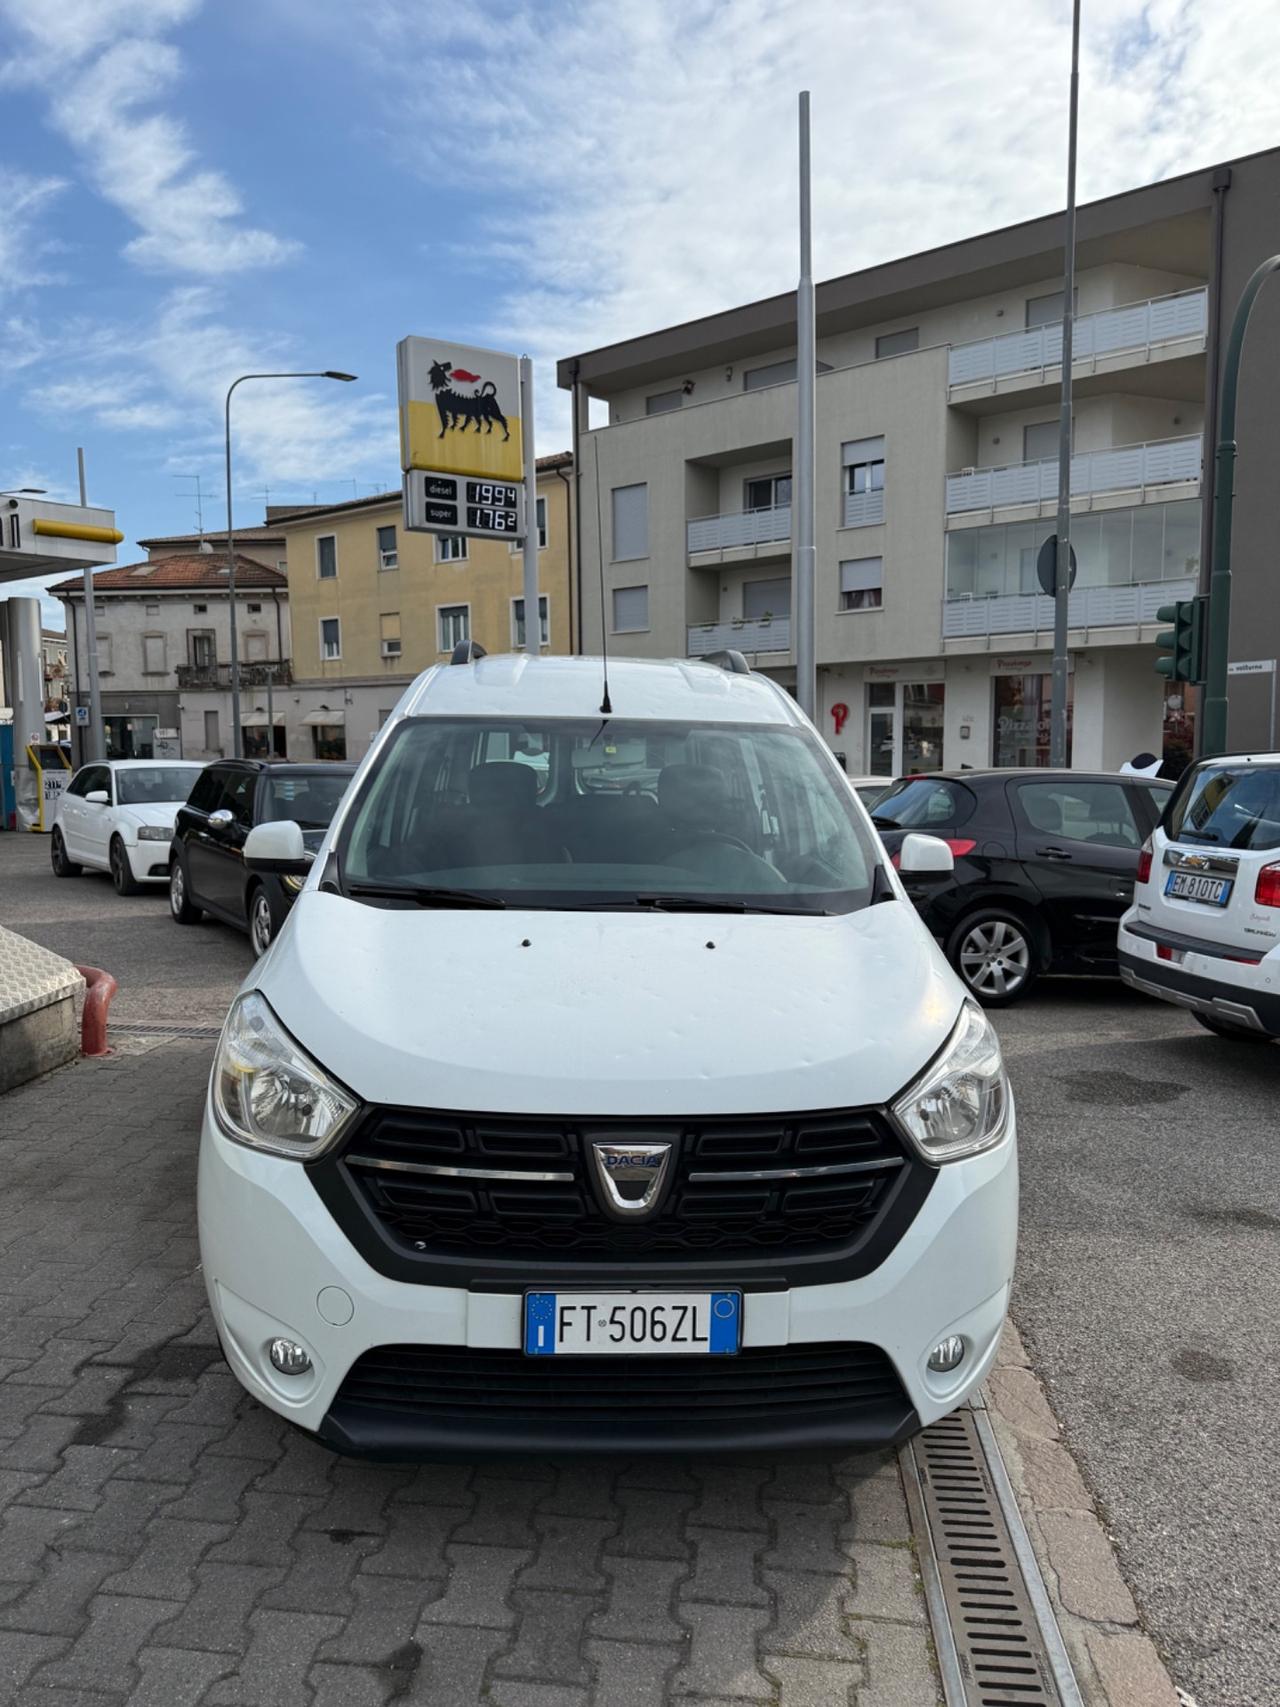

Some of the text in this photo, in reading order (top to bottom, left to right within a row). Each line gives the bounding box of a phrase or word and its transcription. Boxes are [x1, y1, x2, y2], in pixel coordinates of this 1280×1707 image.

[429, 484, 452, 496] diesel
[430, 509, 452, 519] super
[606, 1155, 659, 1168] DACIA
